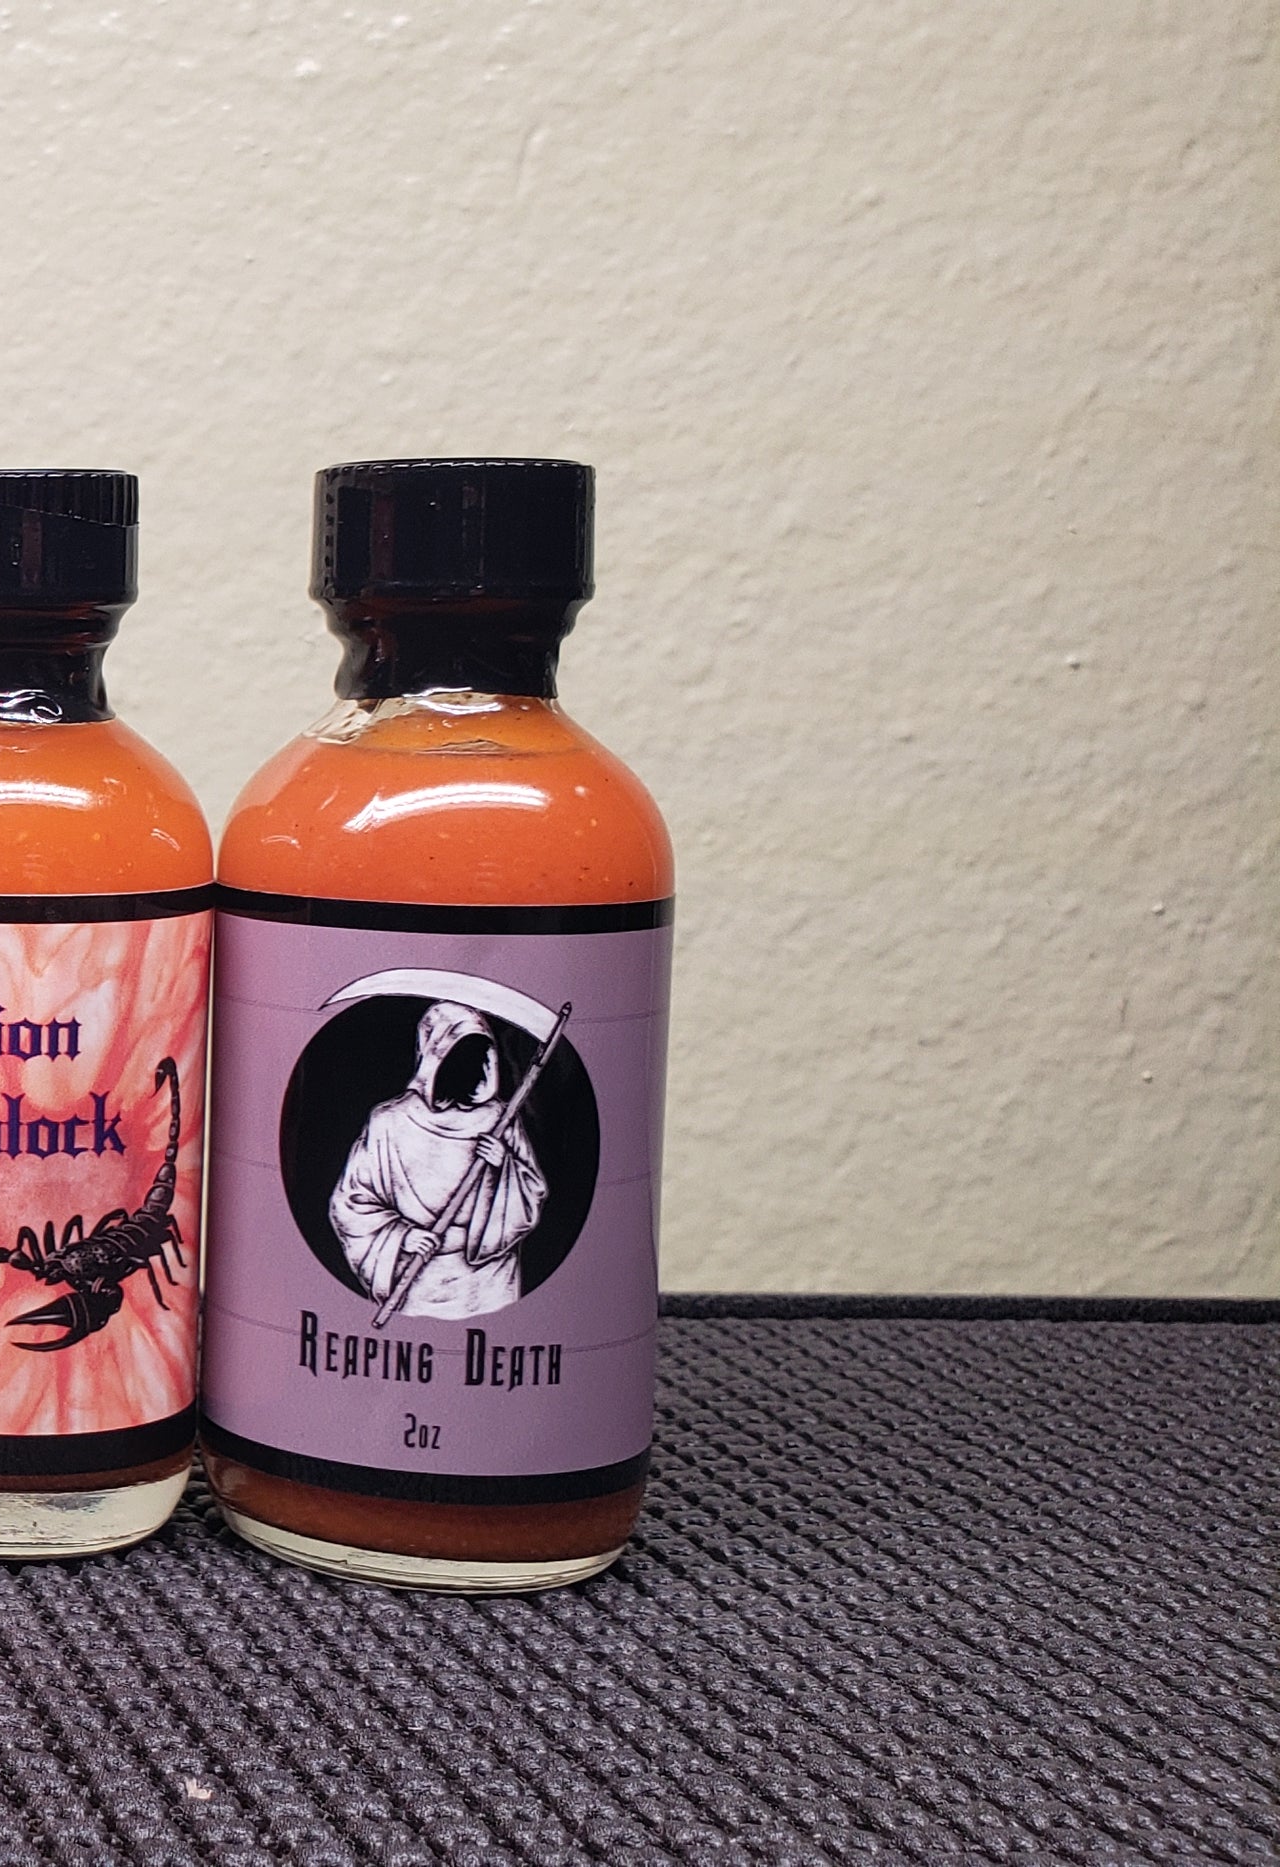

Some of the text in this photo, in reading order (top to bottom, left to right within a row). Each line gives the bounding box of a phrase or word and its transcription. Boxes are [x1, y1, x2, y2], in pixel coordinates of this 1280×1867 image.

[298, 1309, 563, 1393] REAPING DEATH
[402, 1412, 442, 1451] 2oz
